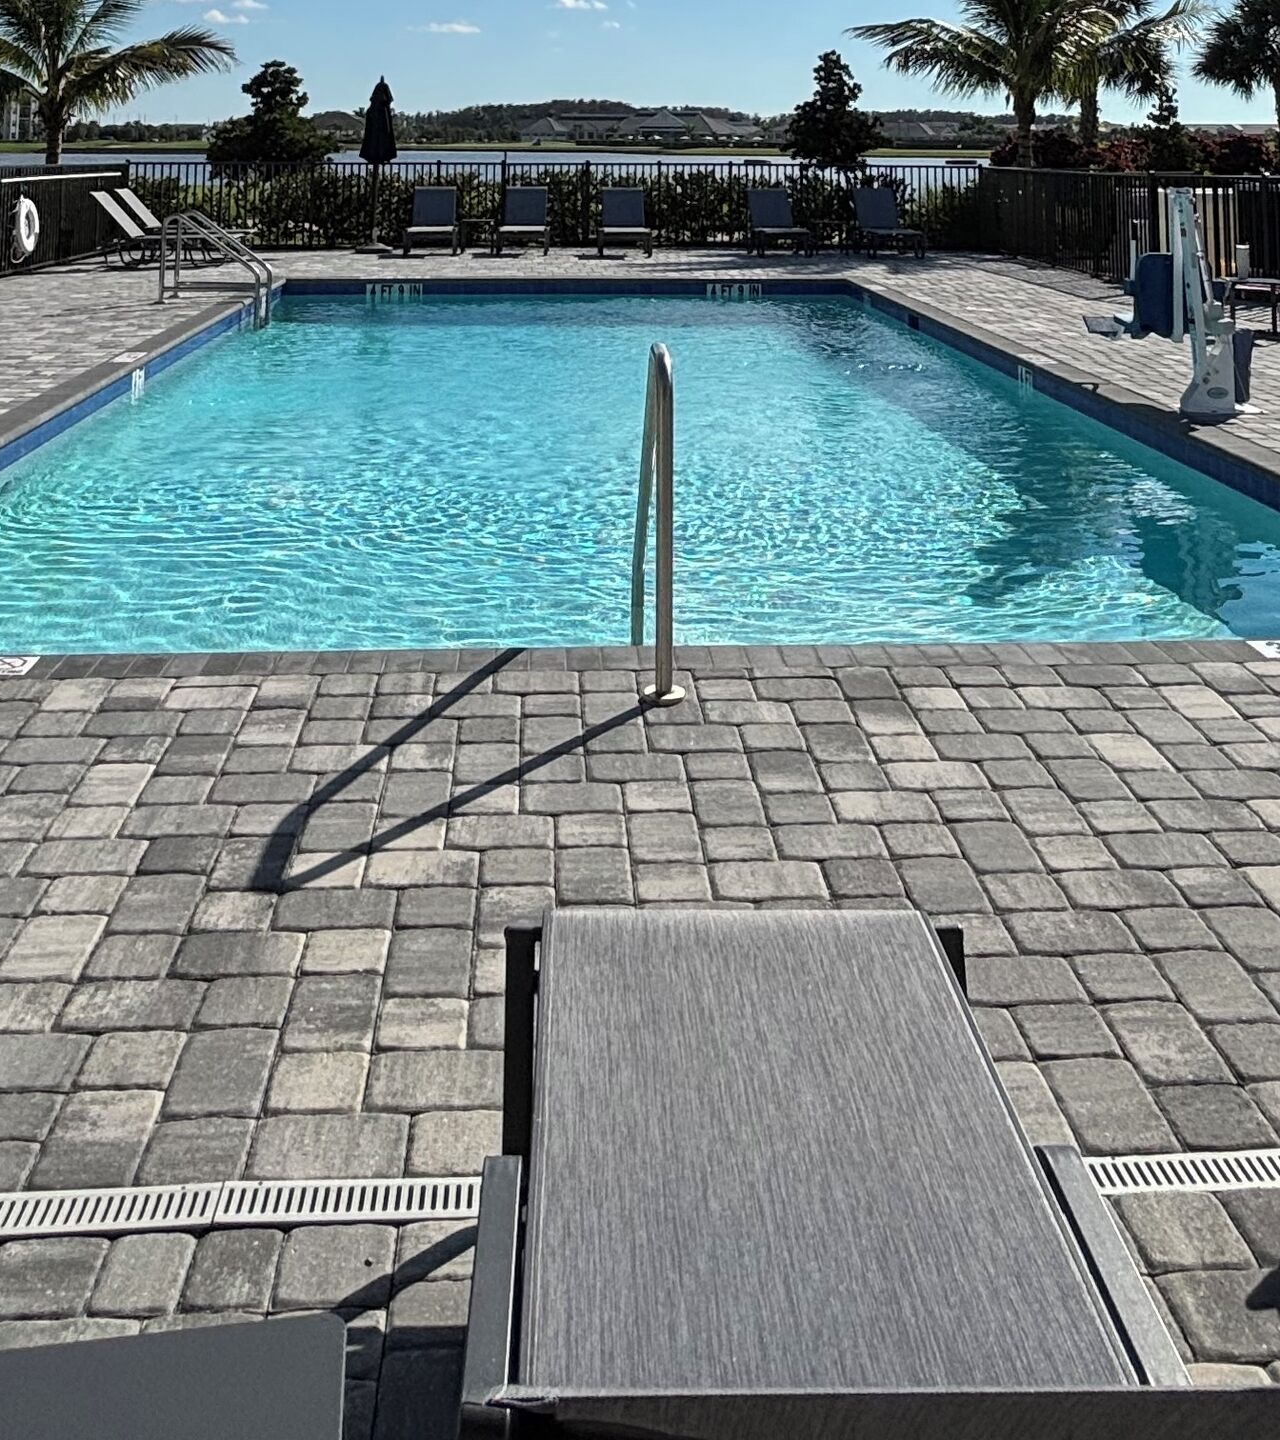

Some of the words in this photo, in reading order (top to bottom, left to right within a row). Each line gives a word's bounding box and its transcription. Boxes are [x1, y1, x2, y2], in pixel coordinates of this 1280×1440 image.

[381, 285, 394, 296] FT
[409, 284, 421, 296] IN
[721, 284, 733, 296] FT
[749, 284, 760, 296] IN
